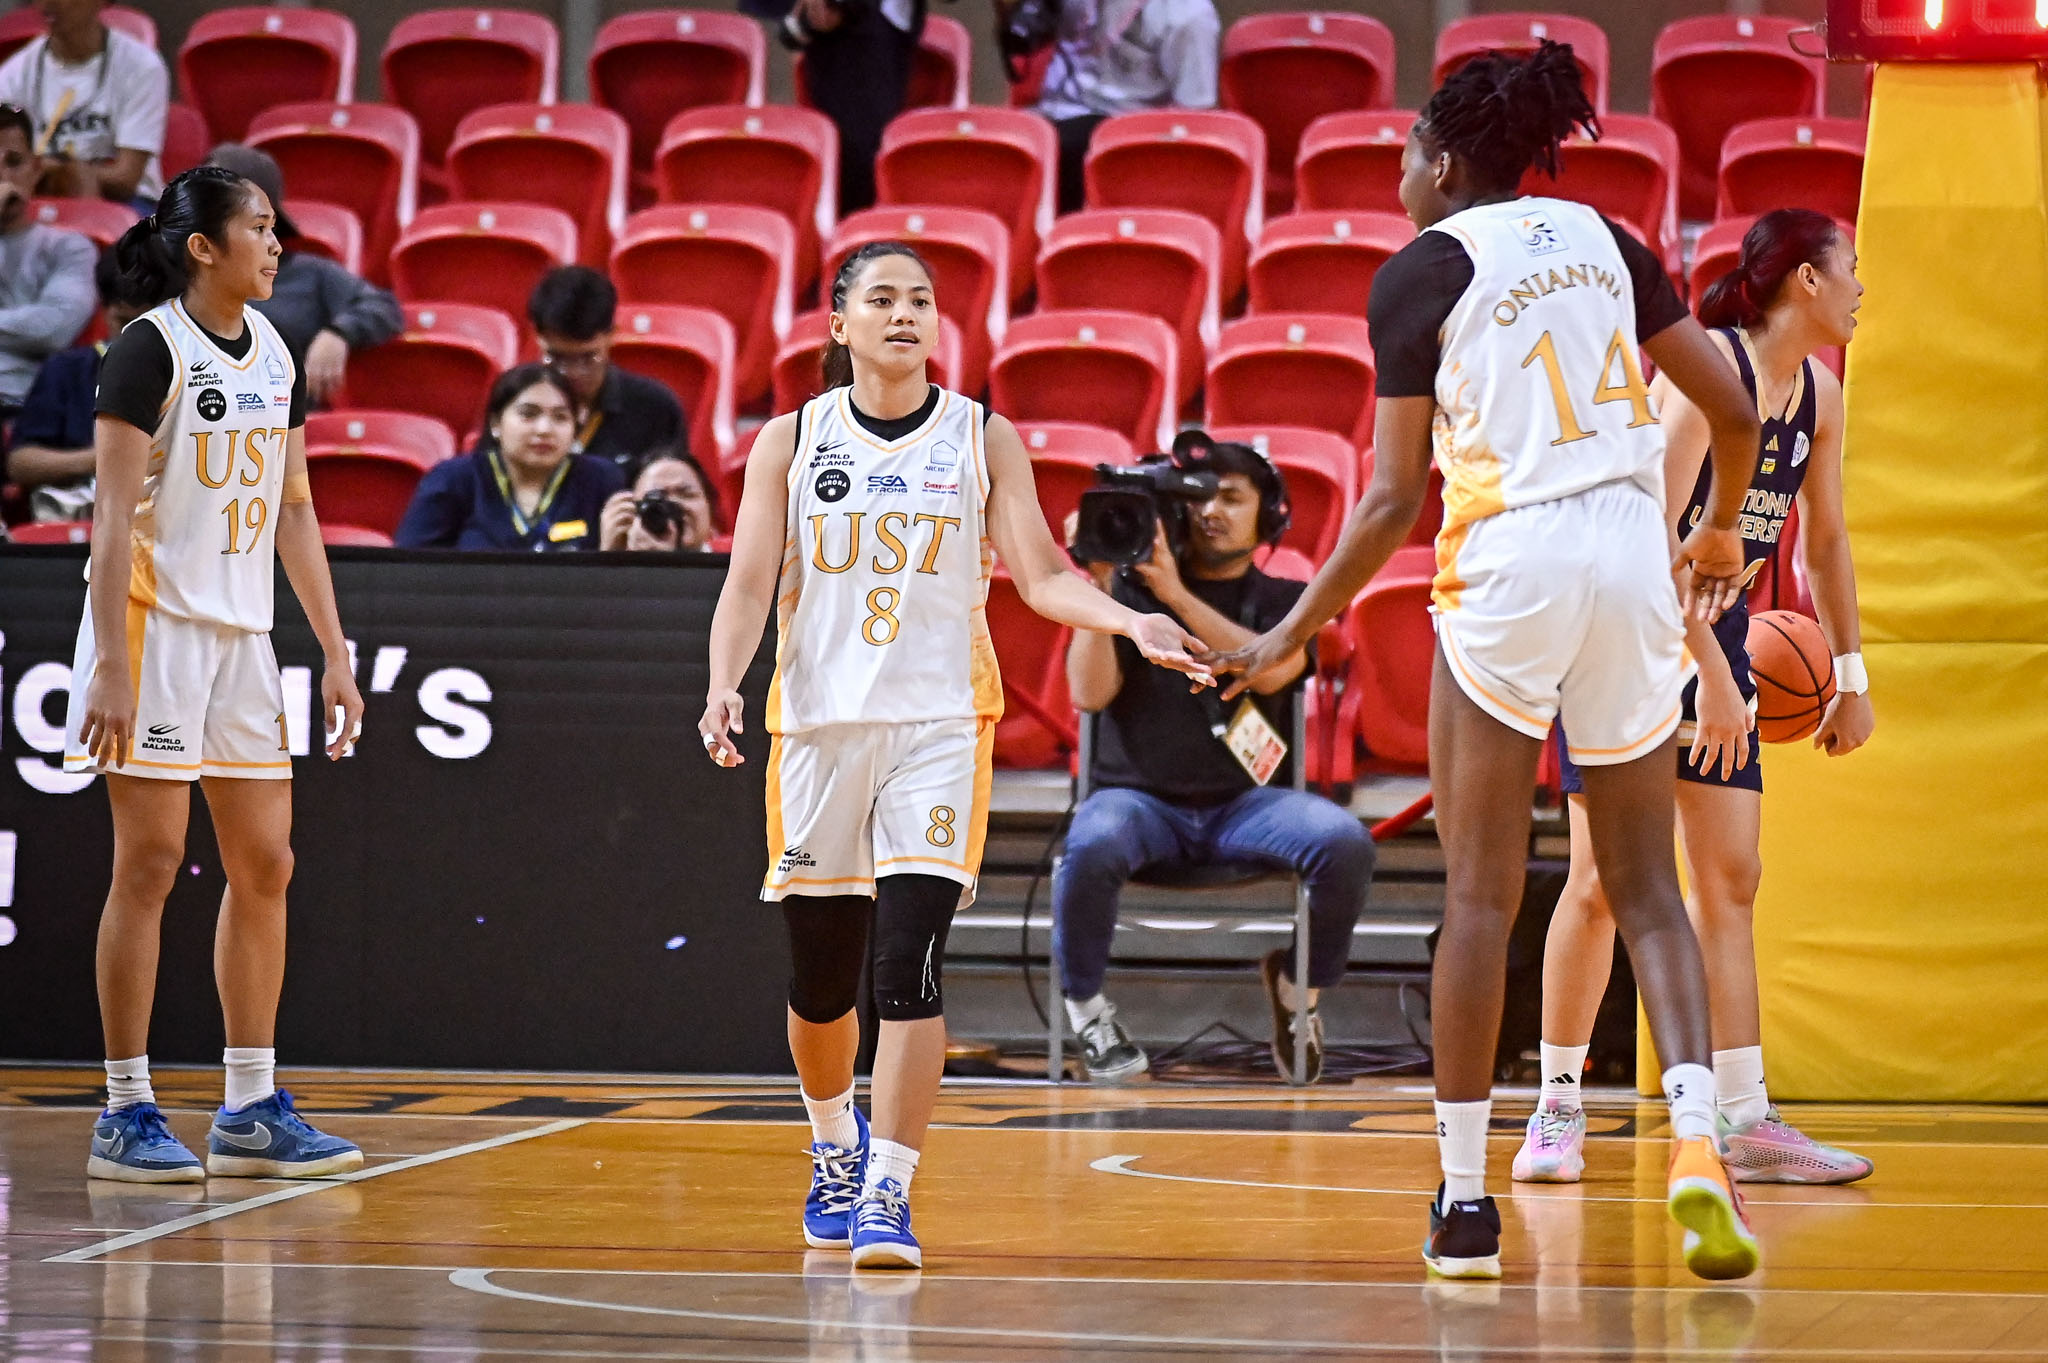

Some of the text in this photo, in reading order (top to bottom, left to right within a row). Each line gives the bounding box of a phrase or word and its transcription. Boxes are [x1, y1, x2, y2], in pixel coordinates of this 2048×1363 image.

[192, 372, 219, 381] WORLD
[187, 379, 224, 388] BALANCE
[1521, 328, 1661, 447] 14
[237, 404, 266, 412] STRONG
[814, 453, 851, 462] WORLD
[809, 460, 856, 469] BALANCE
[818, 479, 847, 489] AURORA
[221, 497, 267, 554] 19
[807, 511, 961, 576] UST
[861, 586, 901, 647] 8
[147, 736, 181, 745] WORLD
[141, 743, 185, 752] BALANCE
[925, 805, 956, 848] 8
